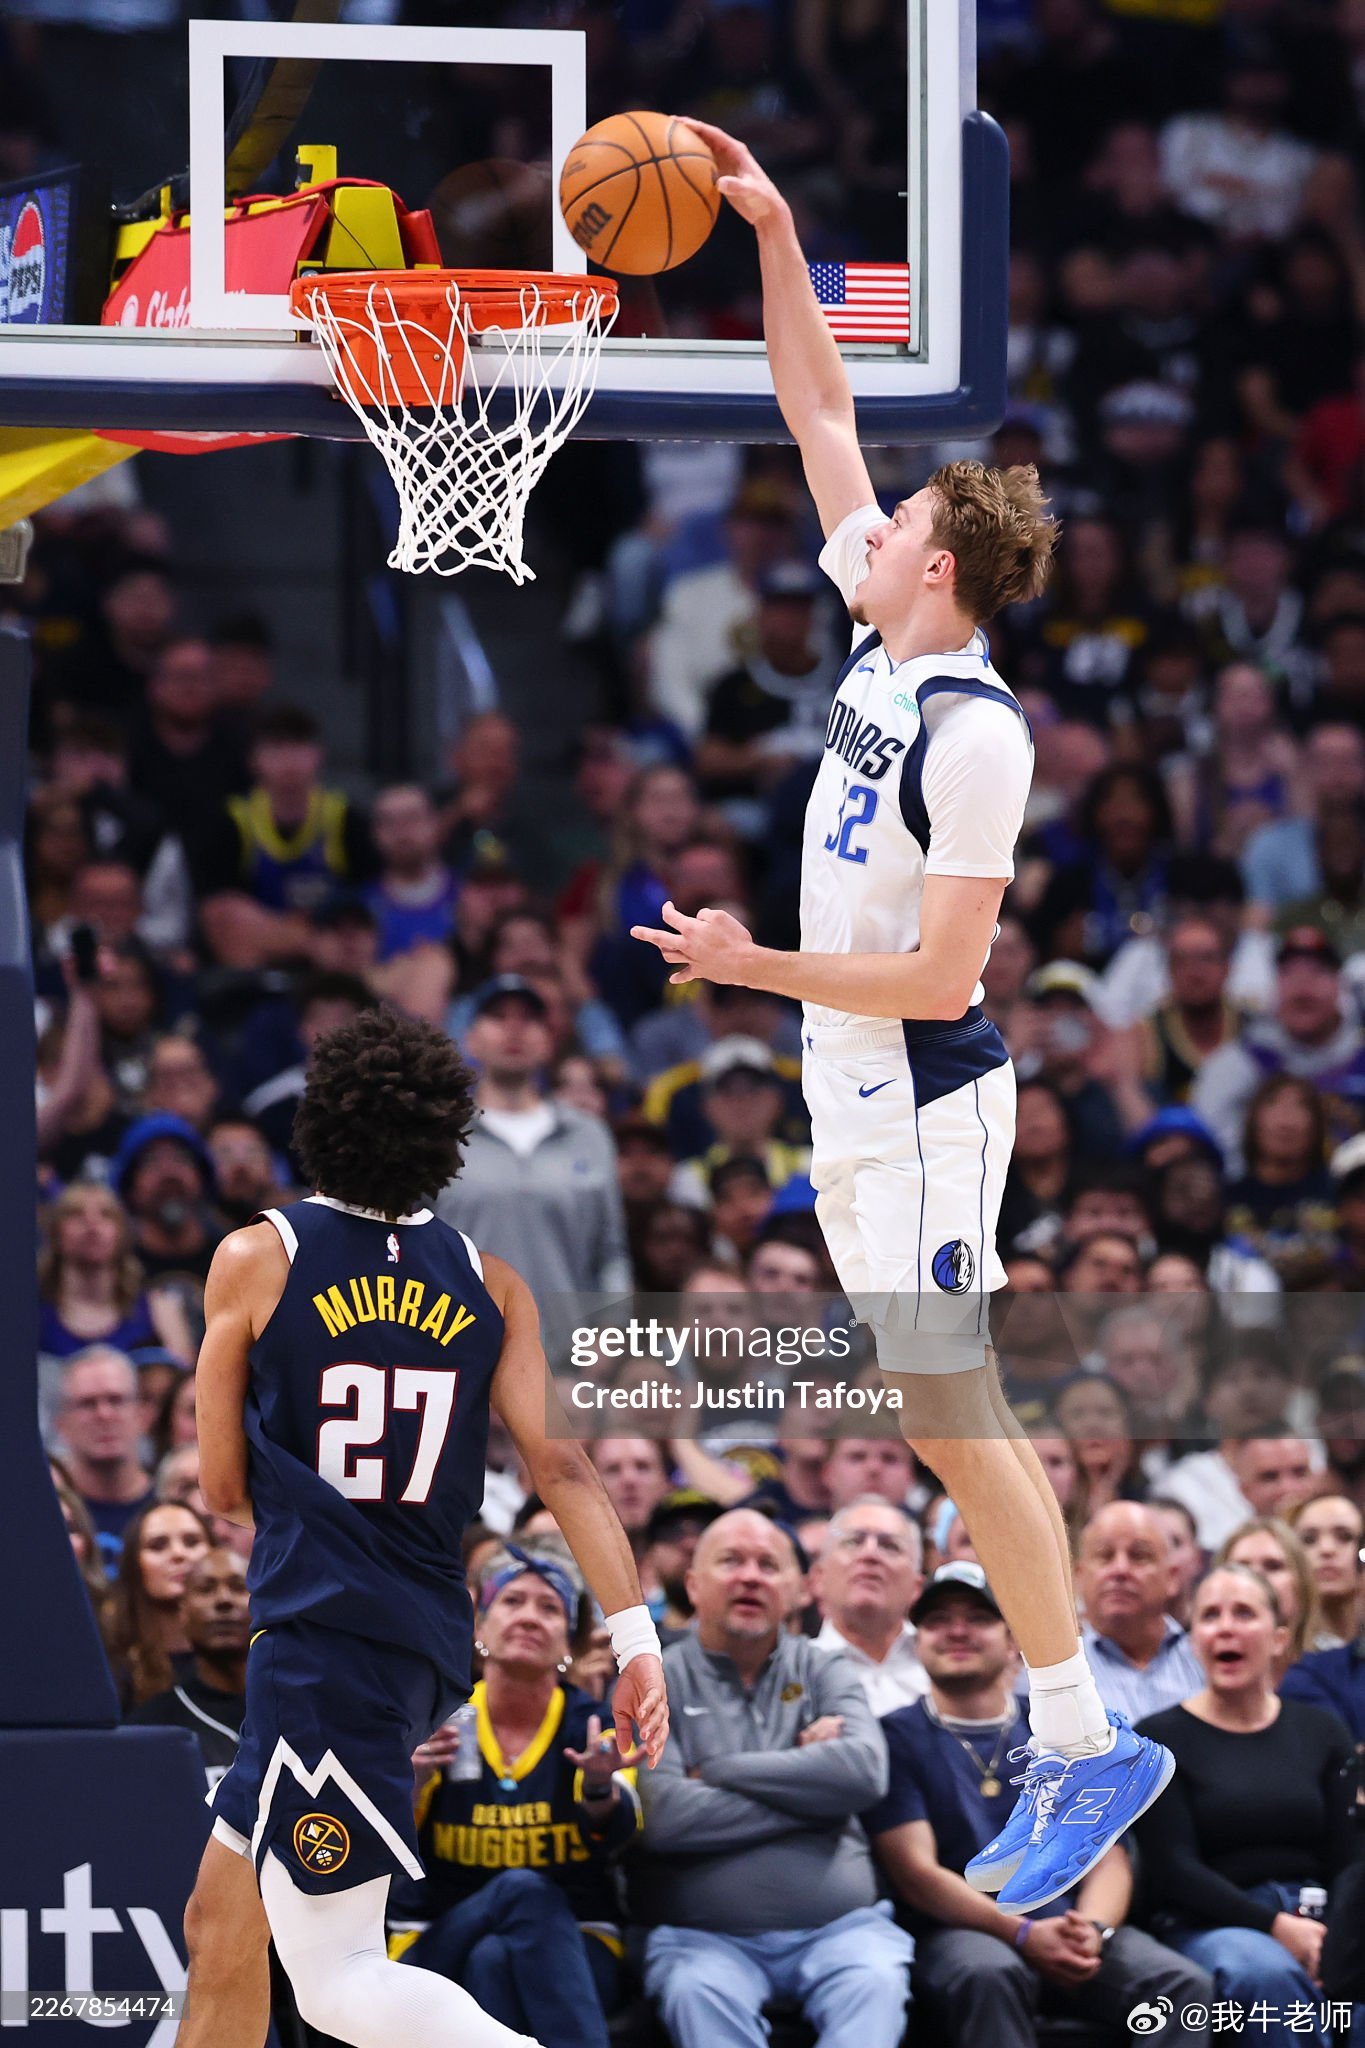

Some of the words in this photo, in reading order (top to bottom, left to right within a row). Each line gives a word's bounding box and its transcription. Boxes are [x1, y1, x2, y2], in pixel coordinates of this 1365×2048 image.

[146, 286, 191, 329] Stat
[312, 1275, 477, 1347] MURRAY
[316, 1361, 460, 1506] 27
[472, 1801, 552, 1827] DENVER
